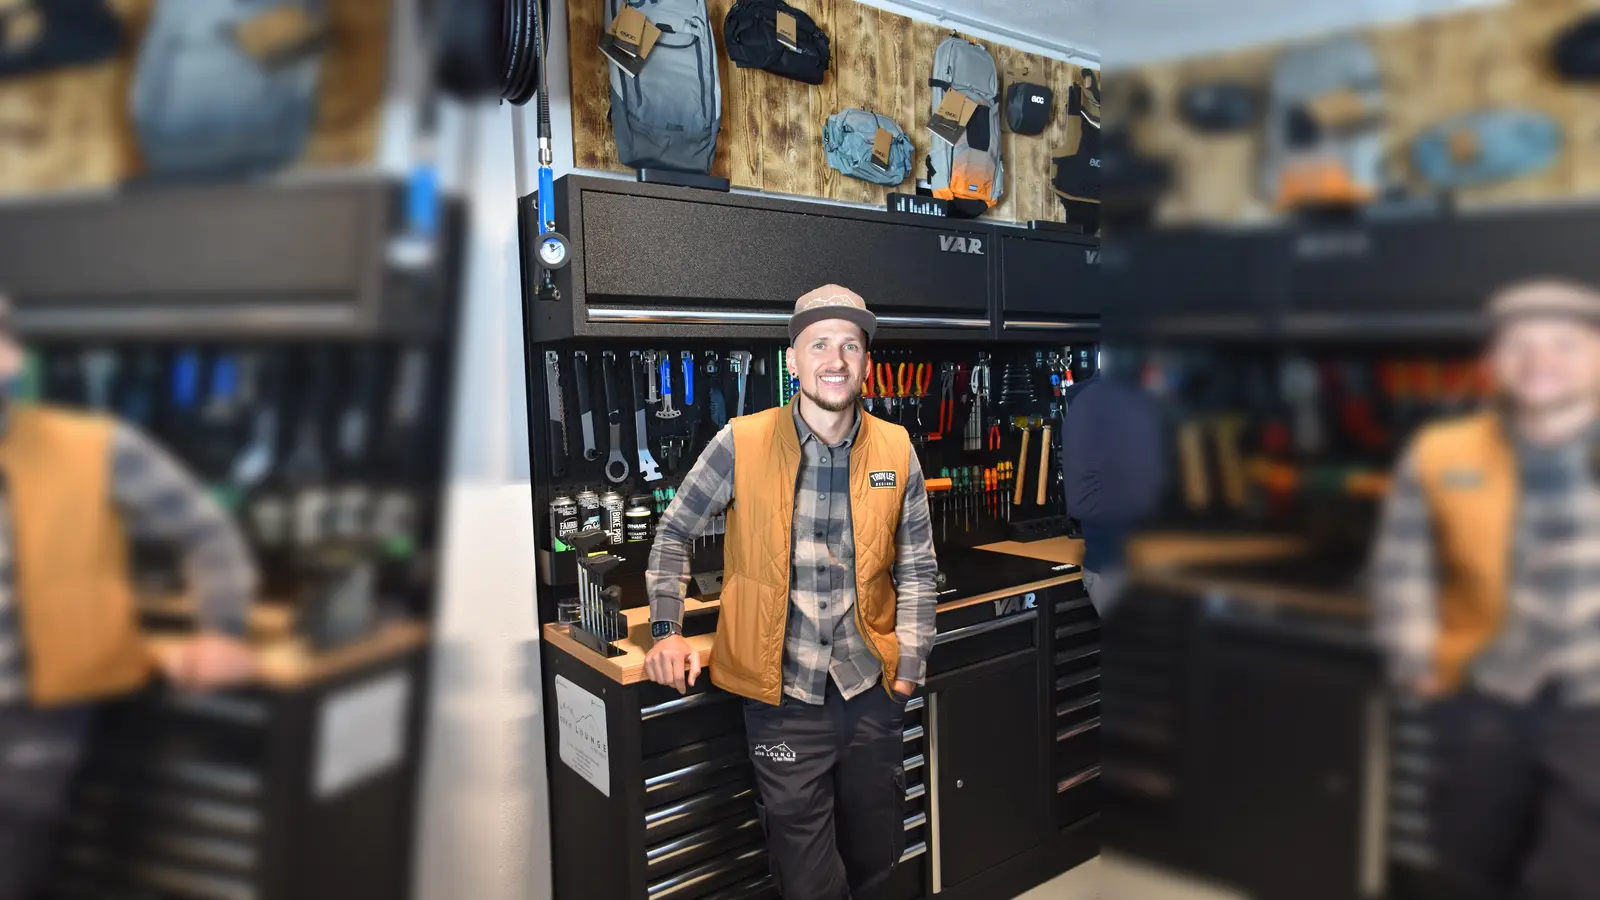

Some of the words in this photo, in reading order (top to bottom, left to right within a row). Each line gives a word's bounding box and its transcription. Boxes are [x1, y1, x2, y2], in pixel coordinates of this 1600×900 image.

[1031, 95, 1045, 105] evoc
[938, 234, 985, 255] VAR
[870, 472, 886, 482] TROY
[885, 471, 895, 482] LEE
[612, 511, 621, 528] BIKE
[993, 592, 1039, 617] VAR
[575, 724, 607, 753] LOUNGE
